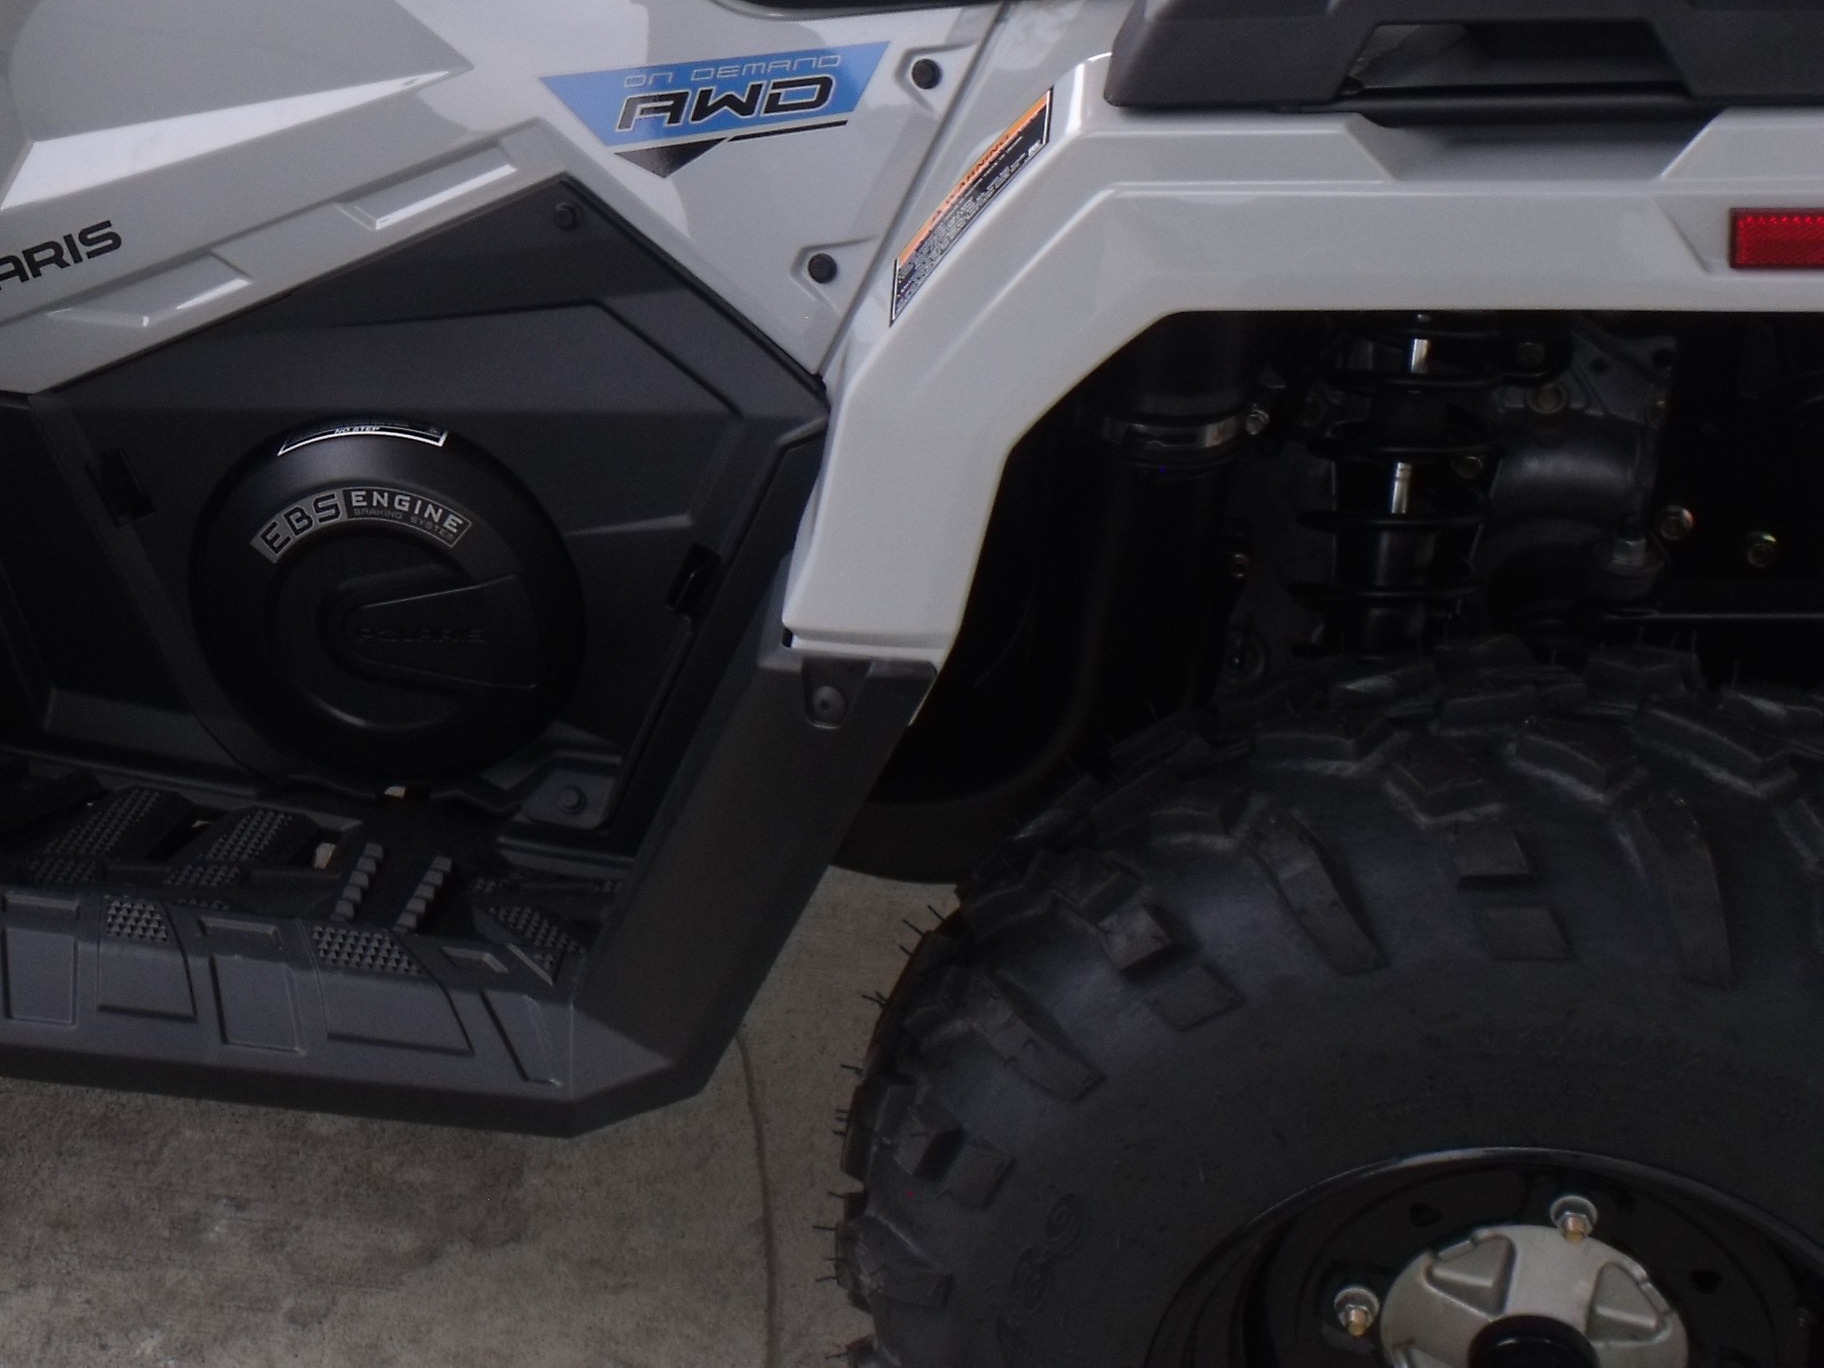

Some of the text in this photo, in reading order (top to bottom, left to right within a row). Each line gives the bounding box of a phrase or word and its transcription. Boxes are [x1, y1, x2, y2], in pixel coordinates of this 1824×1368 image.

[623, 54, 842, 88] ON DEMAND
[614, 74, 835, 132] AWD
[260, 490, 464, 555] EBS ENGINE
[352, 507, 455, 540] BRAKING SYSTEM
